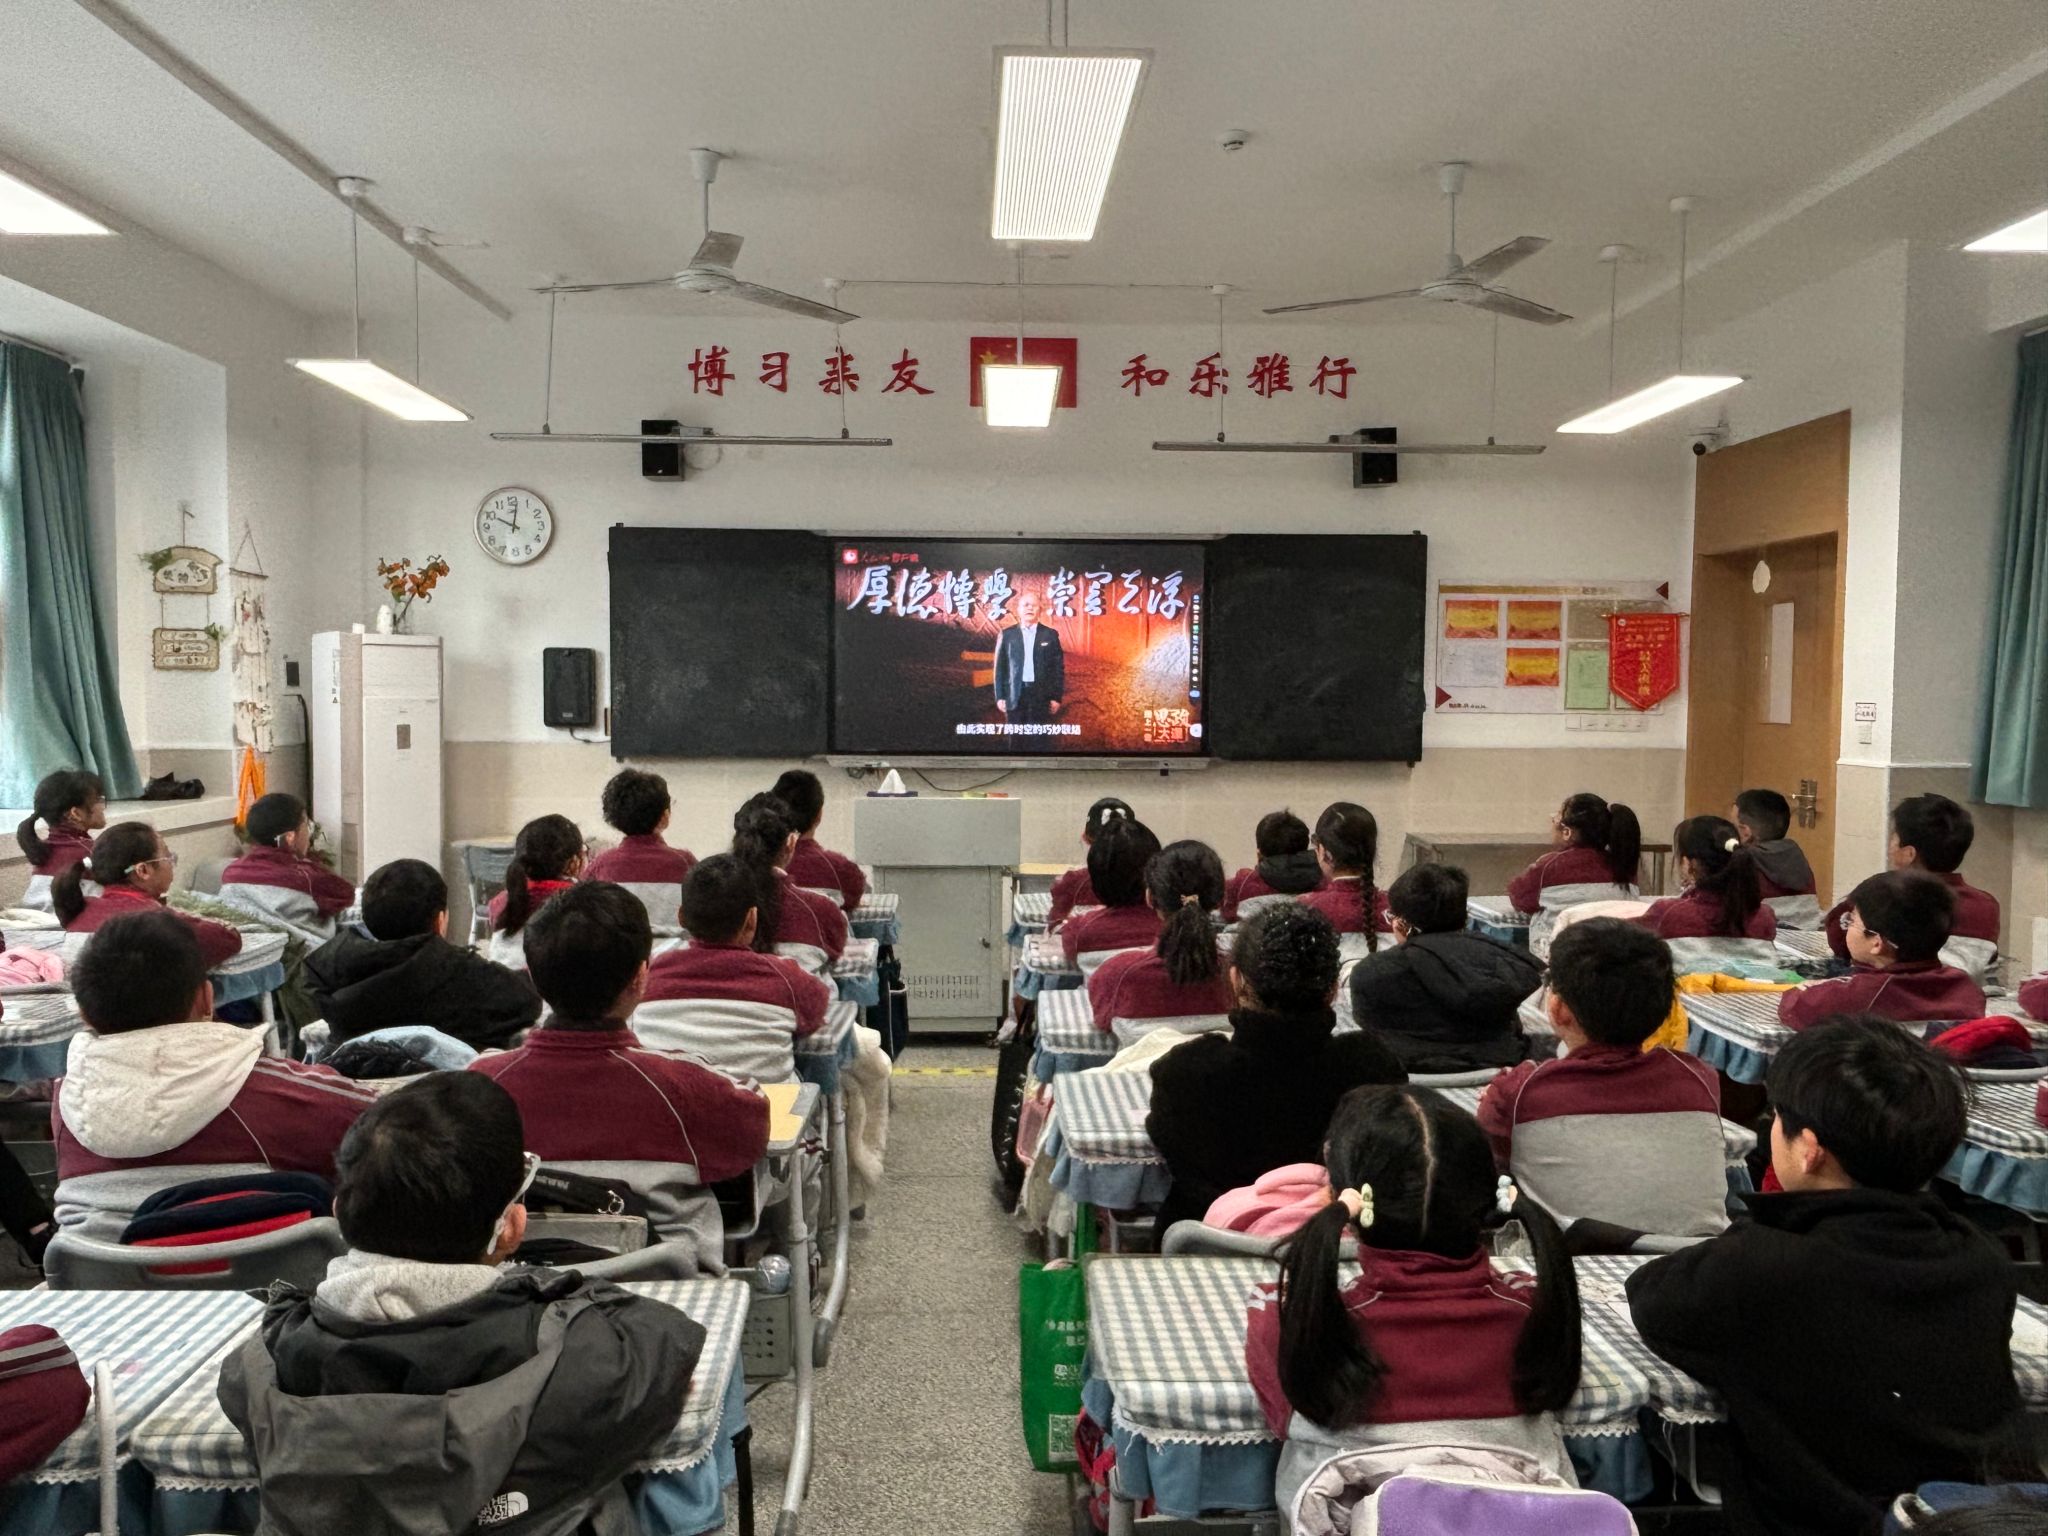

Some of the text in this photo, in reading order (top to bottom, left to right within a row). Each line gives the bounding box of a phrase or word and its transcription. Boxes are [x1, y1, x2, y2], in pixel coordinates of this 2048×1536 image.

[1121, 352, 1357, 400] 和乐雅行
[495, 500, 504, 510] 11
[485, 511, 496, 521] 10
[533, 509, 542, 519] 2
[483, 523, 491, 533] 9
[537, 521, 545, 531] 3
[488, 536, 496, 545] 8
[499, 545, 507, 556] 7
[525, 545, 533, 555] 5
